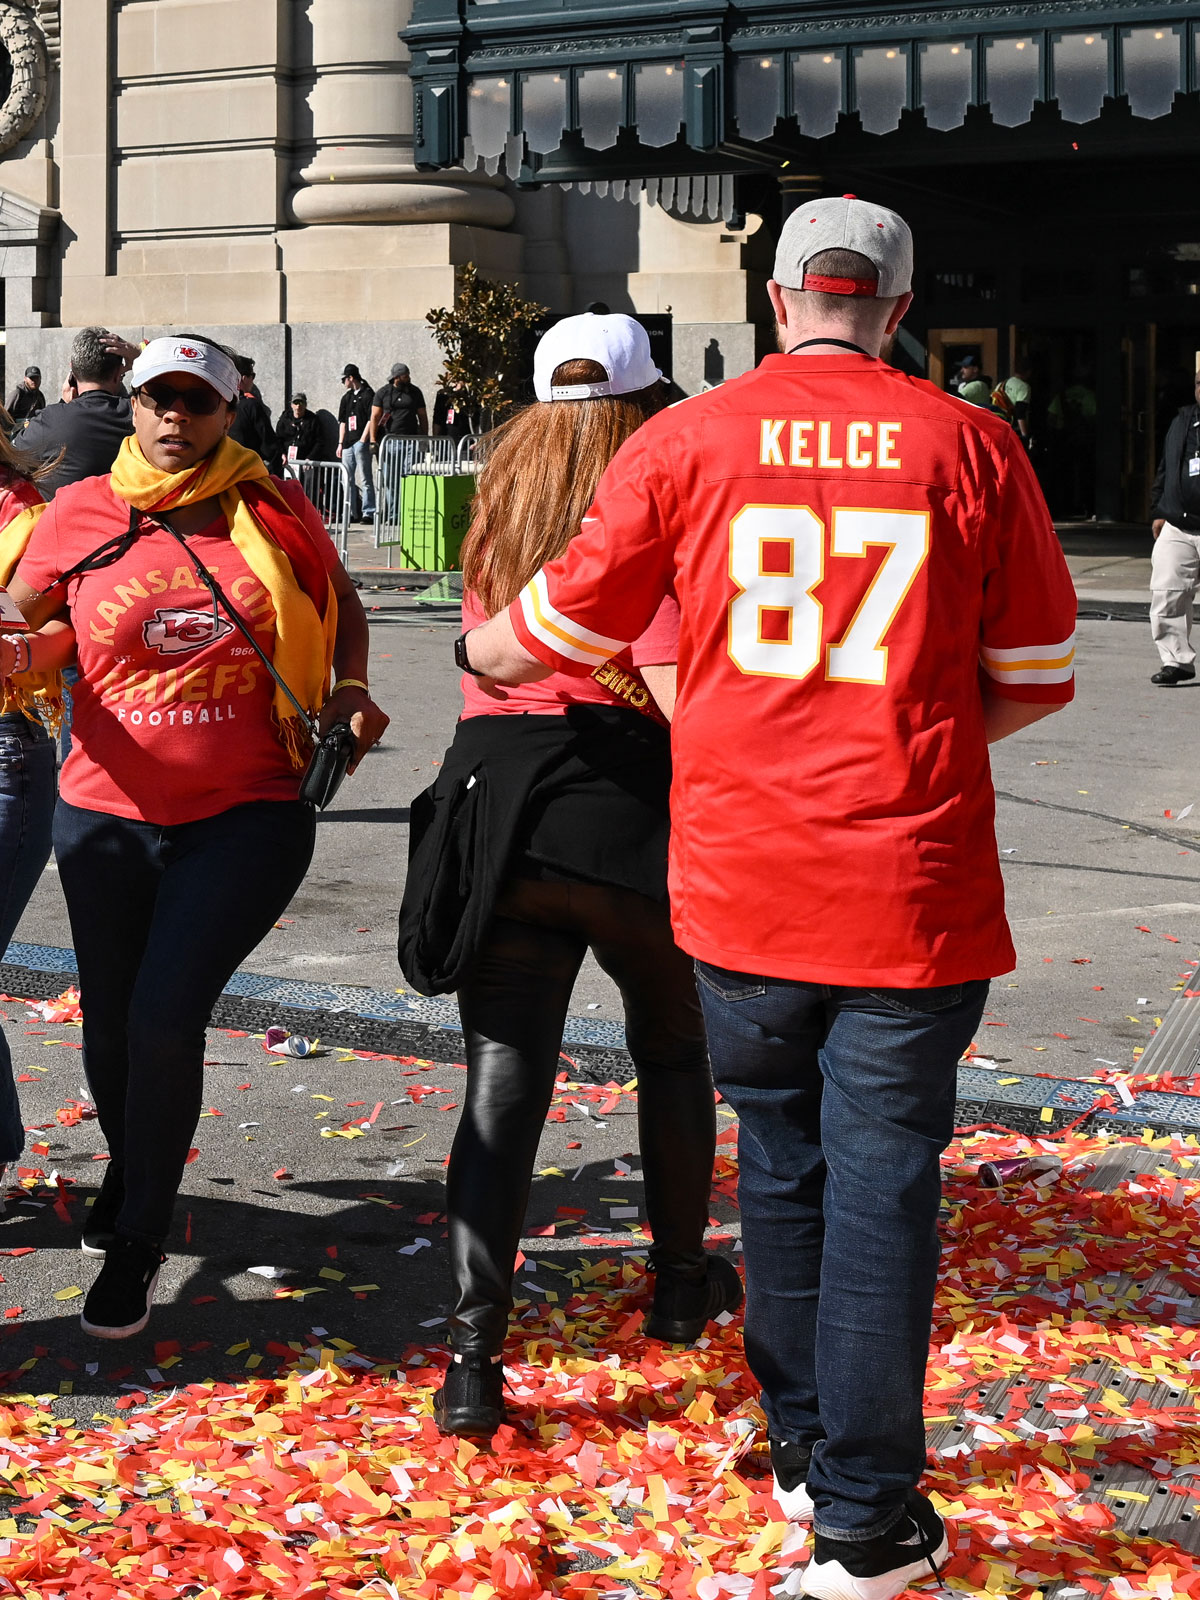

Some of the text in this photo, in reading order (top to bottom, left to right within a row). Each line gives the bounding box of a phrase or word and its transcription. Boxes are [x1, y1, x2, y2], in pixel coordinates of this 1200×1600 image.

[759, 419, 902, 469] KELCE
[89, 566, 277, 646] KANSAS CITY
[727, 503, 931, 686] 87
[162, 617, 215, 642] KC
[113, 647, 255, 664] EST. 1960
[102, 660, 261, 704] CHIEFS
[117, 704, 236, 726] FOOTBALL
